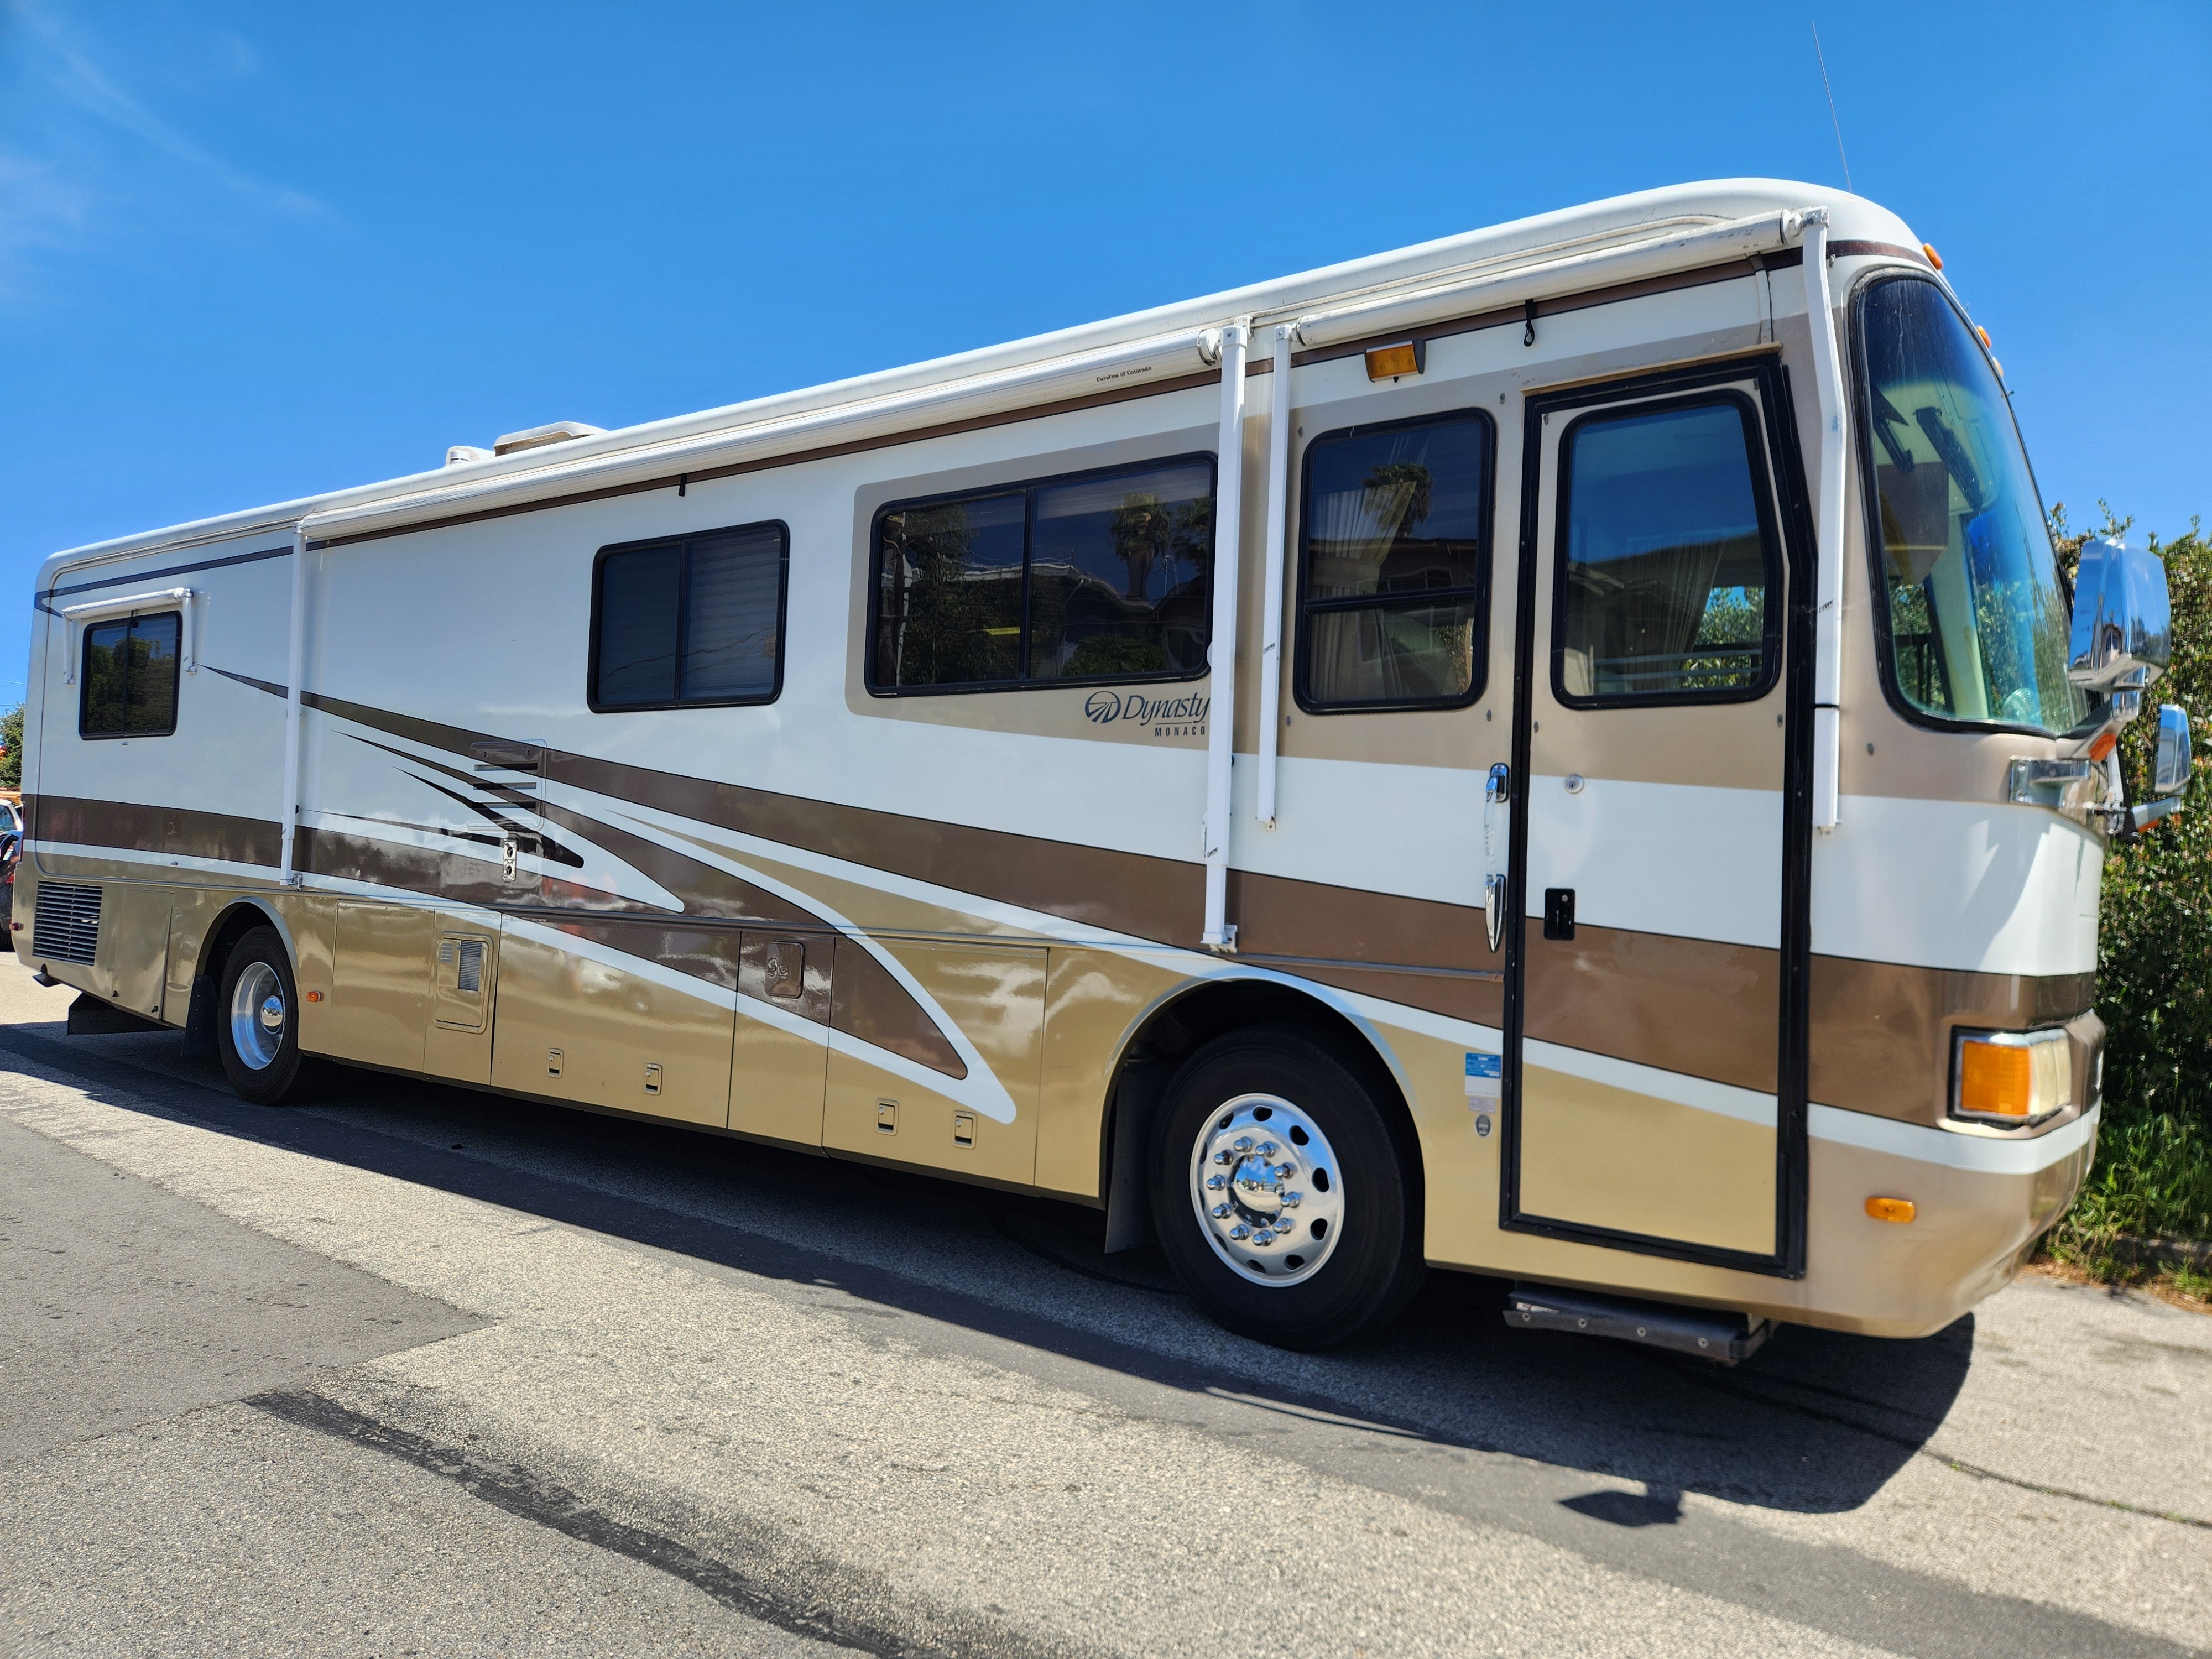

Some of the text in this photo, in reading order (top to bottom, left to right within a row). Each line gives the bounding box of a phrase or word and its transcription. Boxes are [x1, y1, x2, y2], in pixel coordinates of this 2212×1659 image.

[1096, 374, 1119, 382] Carefree
[1126, 366, 1152, 375] Colorado
[1121, 692, 1211, 726] Dynasty
[1155, 726, 1206, 737] MONACO
